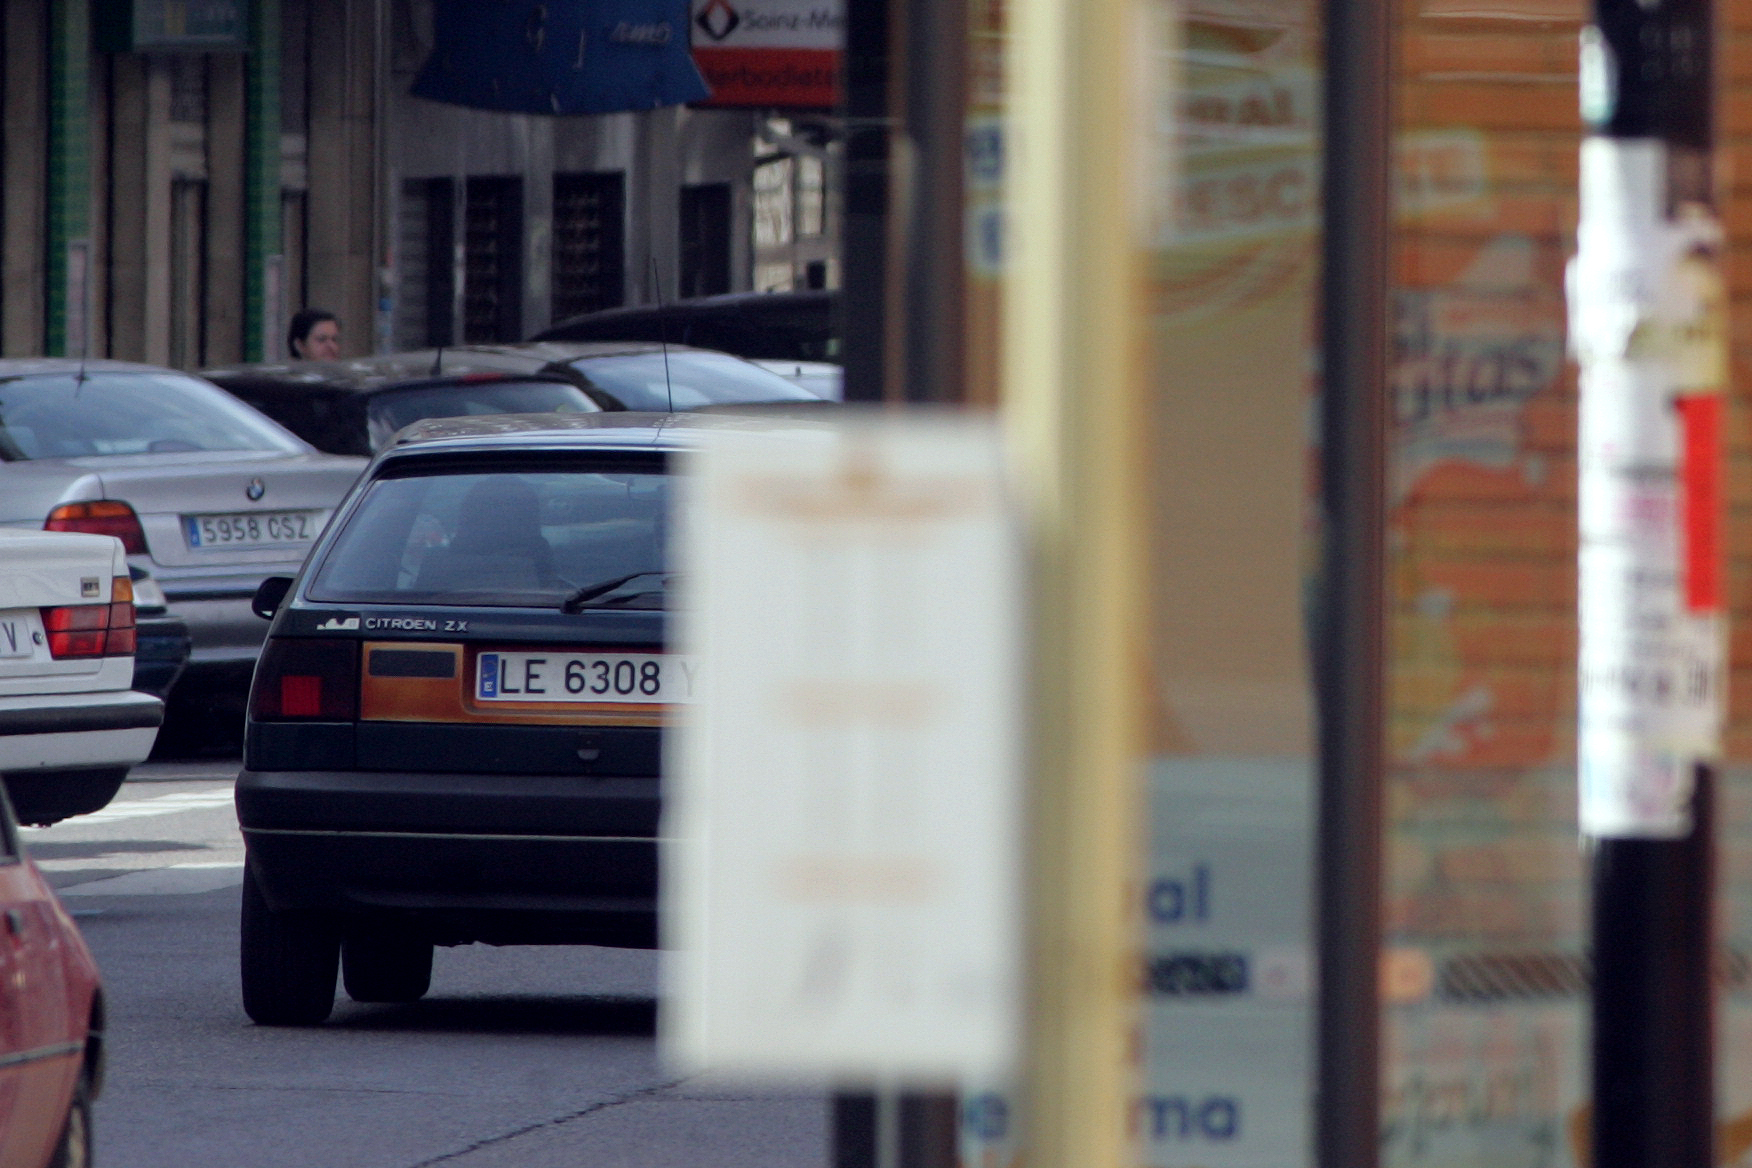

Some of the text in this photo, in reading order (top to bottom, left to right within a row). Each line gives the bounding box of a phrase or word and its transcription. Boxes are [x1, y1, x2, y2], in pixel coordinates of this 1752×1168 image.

[202, 516, 260, 543] 5958
[364, 617, 469, 632] CITROEN ZX
[500, 658, 547, 694] LE
[564, 659, 662, 696] 6308
